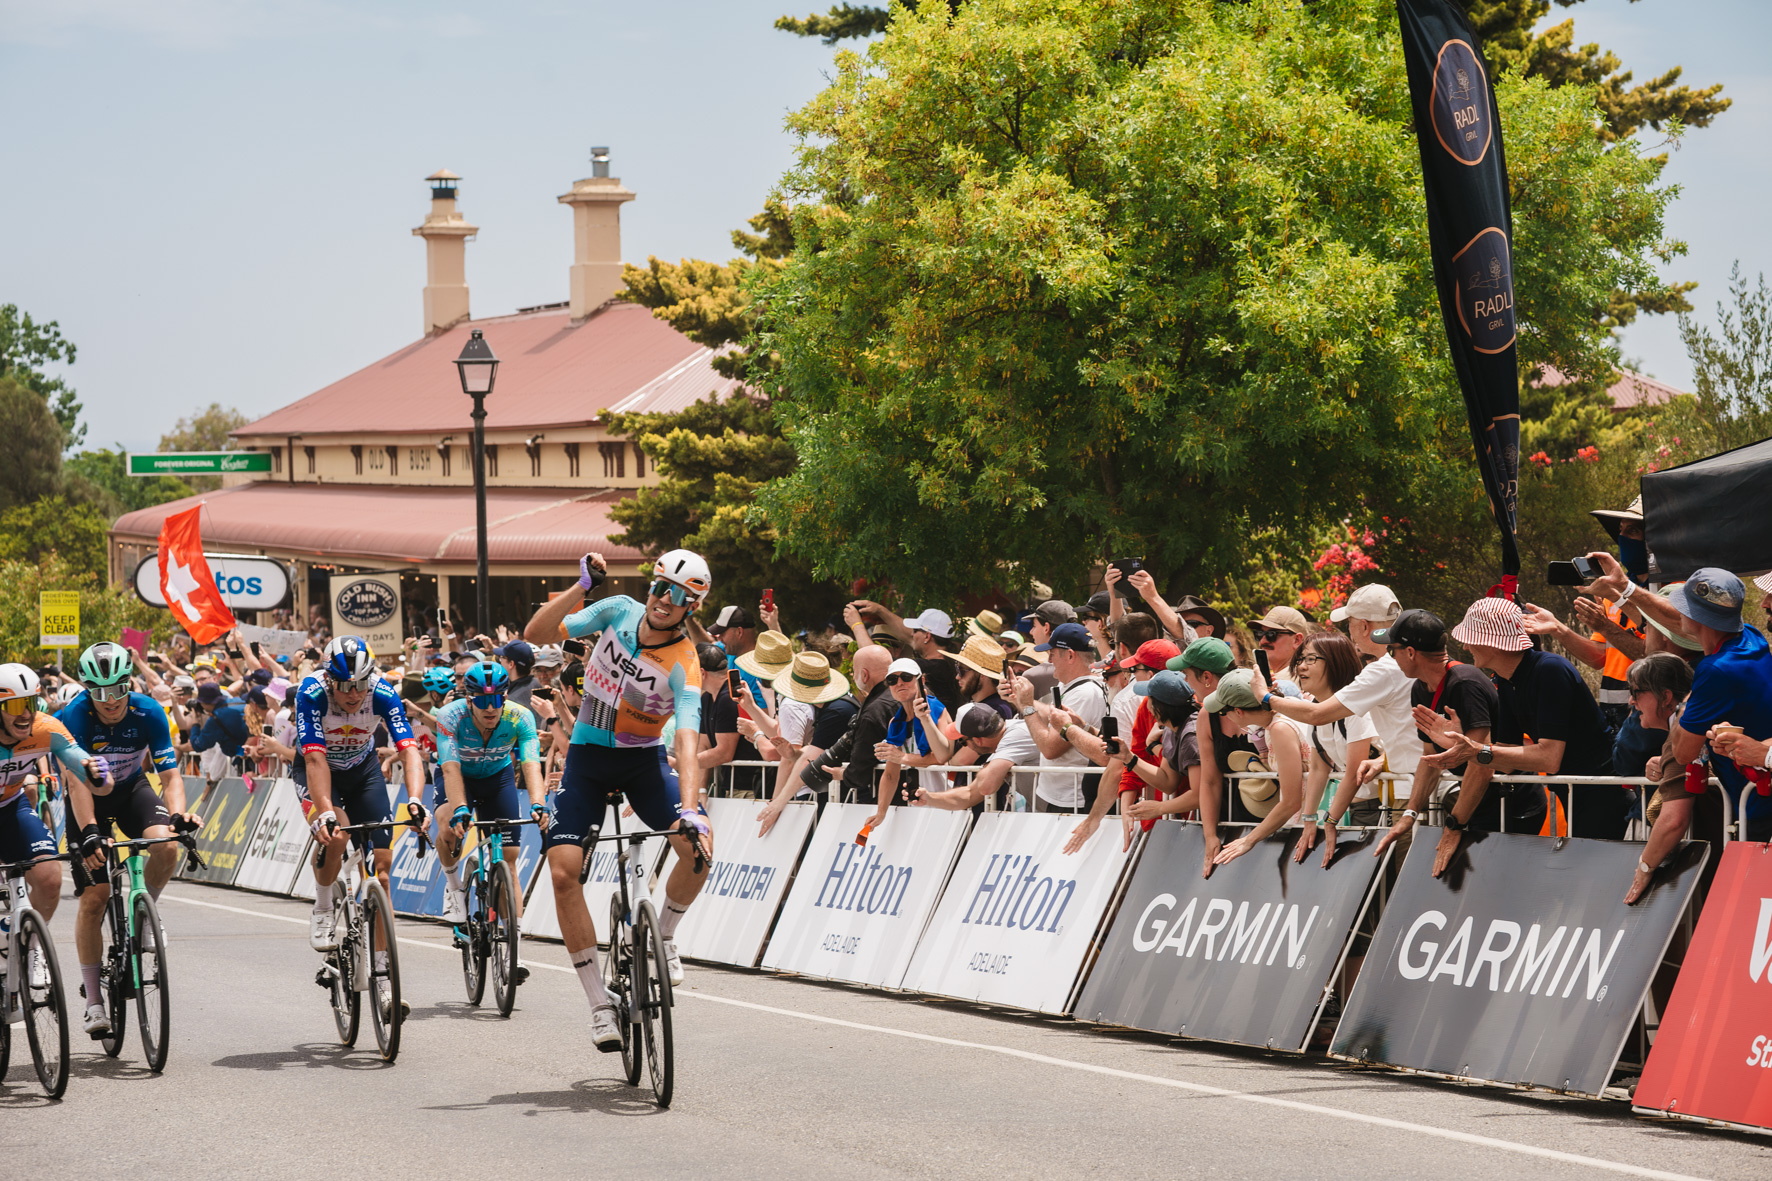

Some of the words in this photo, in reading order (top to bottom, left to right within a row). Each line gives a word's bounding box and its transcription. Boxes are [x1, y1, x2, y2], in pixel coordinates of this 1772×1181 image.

[1454, 104, 1480, 129] RADL
[1475, 291, 1512, 318] RADL
[154, 460, 184, 468] FOREVER
[184, 460, 215, 468] ORIGINAL
[369, 449, 385, 470] OLD
[410, 449, 432, 470] BUSH
[215, 571, 263, 596] tos
[341, 584, 362, 604] OLD
[365, 583, 392, 602] BUSH
[356, 593, 377, 603] INN
[44, 615, 75, 624] KEEP
[44, 624, 75, 634] CLEAR
[372, 633, 395, 641] DAYS
[311, 709, 325, 739] BOSS
[388, 707, 407, 734] BOSS
[814, 842, 913, 917] Hilton
[962, 853, 1077, 934] Hilton
[1132, 892, 1320, 968] GARMIN
[820, 933, 861, 954] ADELAIDE
[1398, 910, 1625, 1000] GARMIN
[966, 951, 1012, 975] ADELAIDE
